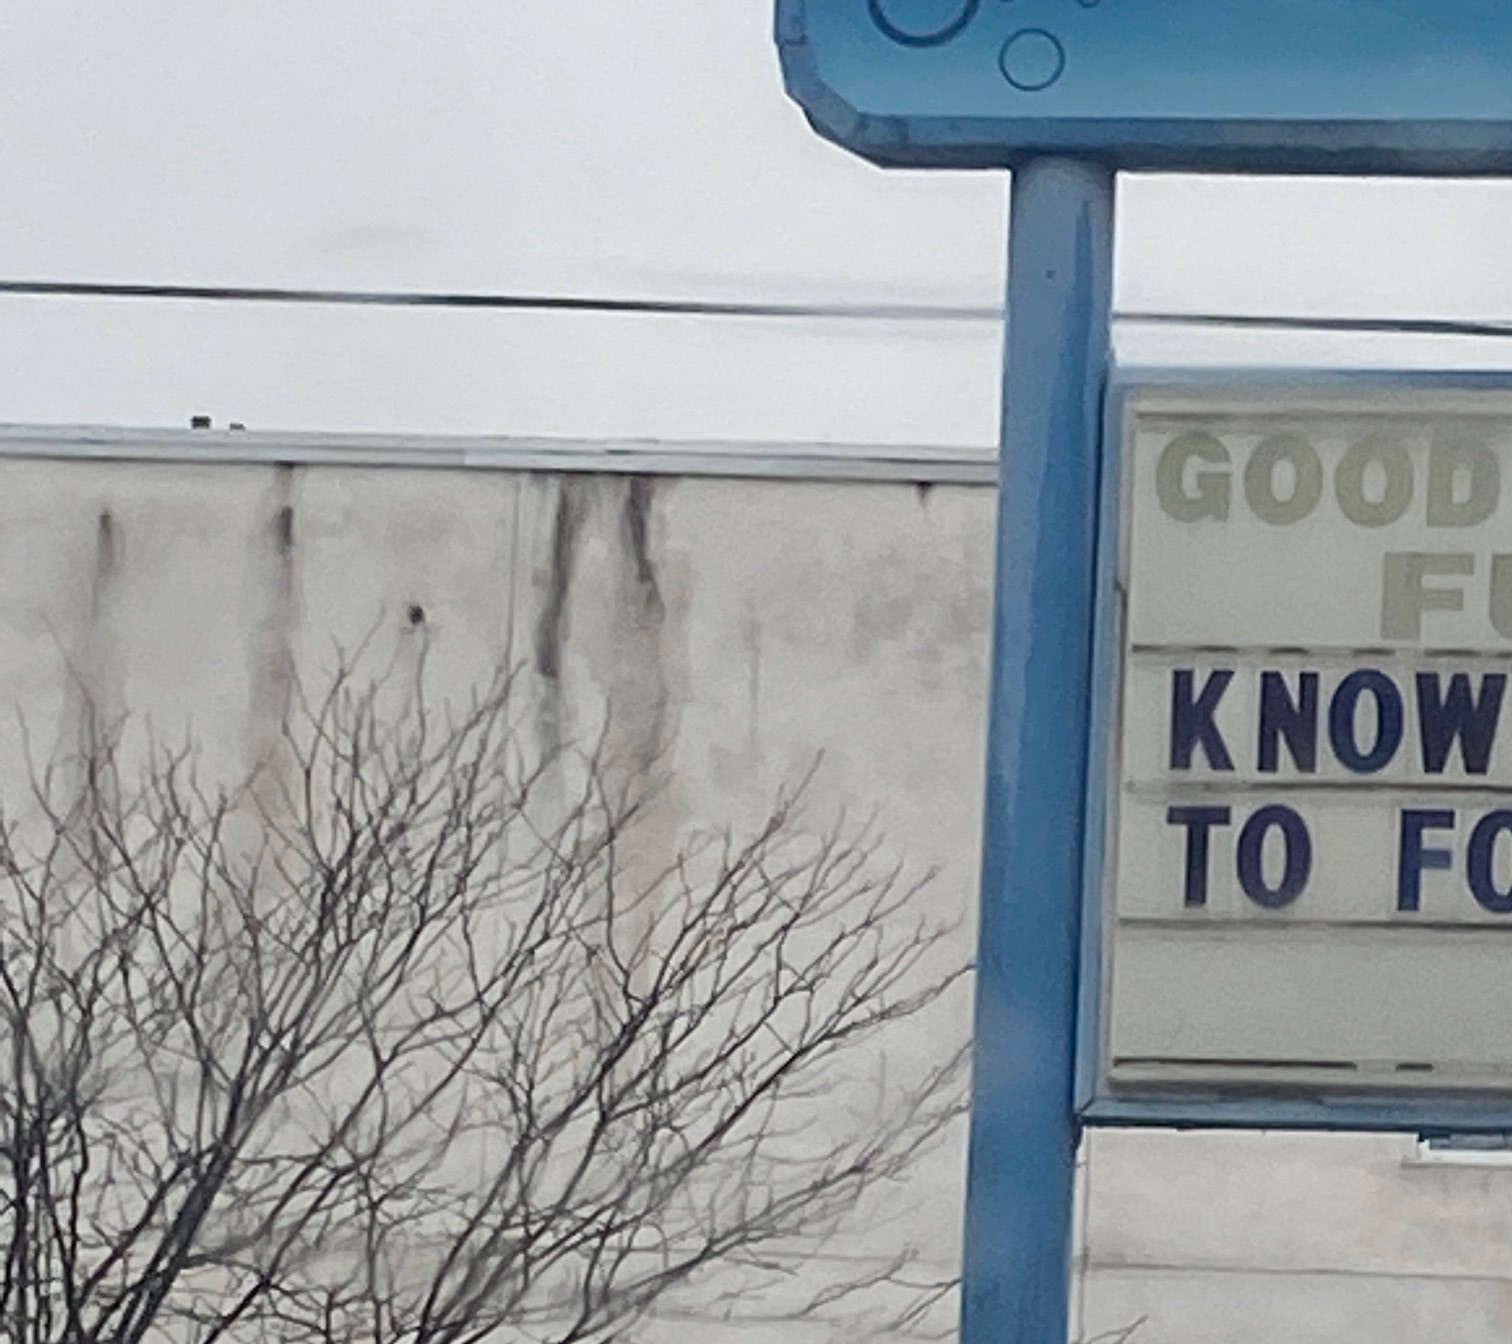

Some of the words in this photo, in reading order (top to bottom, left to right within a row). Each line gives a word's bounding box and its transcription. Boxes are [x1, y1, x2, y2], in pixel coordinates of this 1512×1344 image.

[1153, 429, 1502, 529] GOOD
[1167, 668, 1508, 774] KNOW
[1166, 803, 1313, 911] TO
